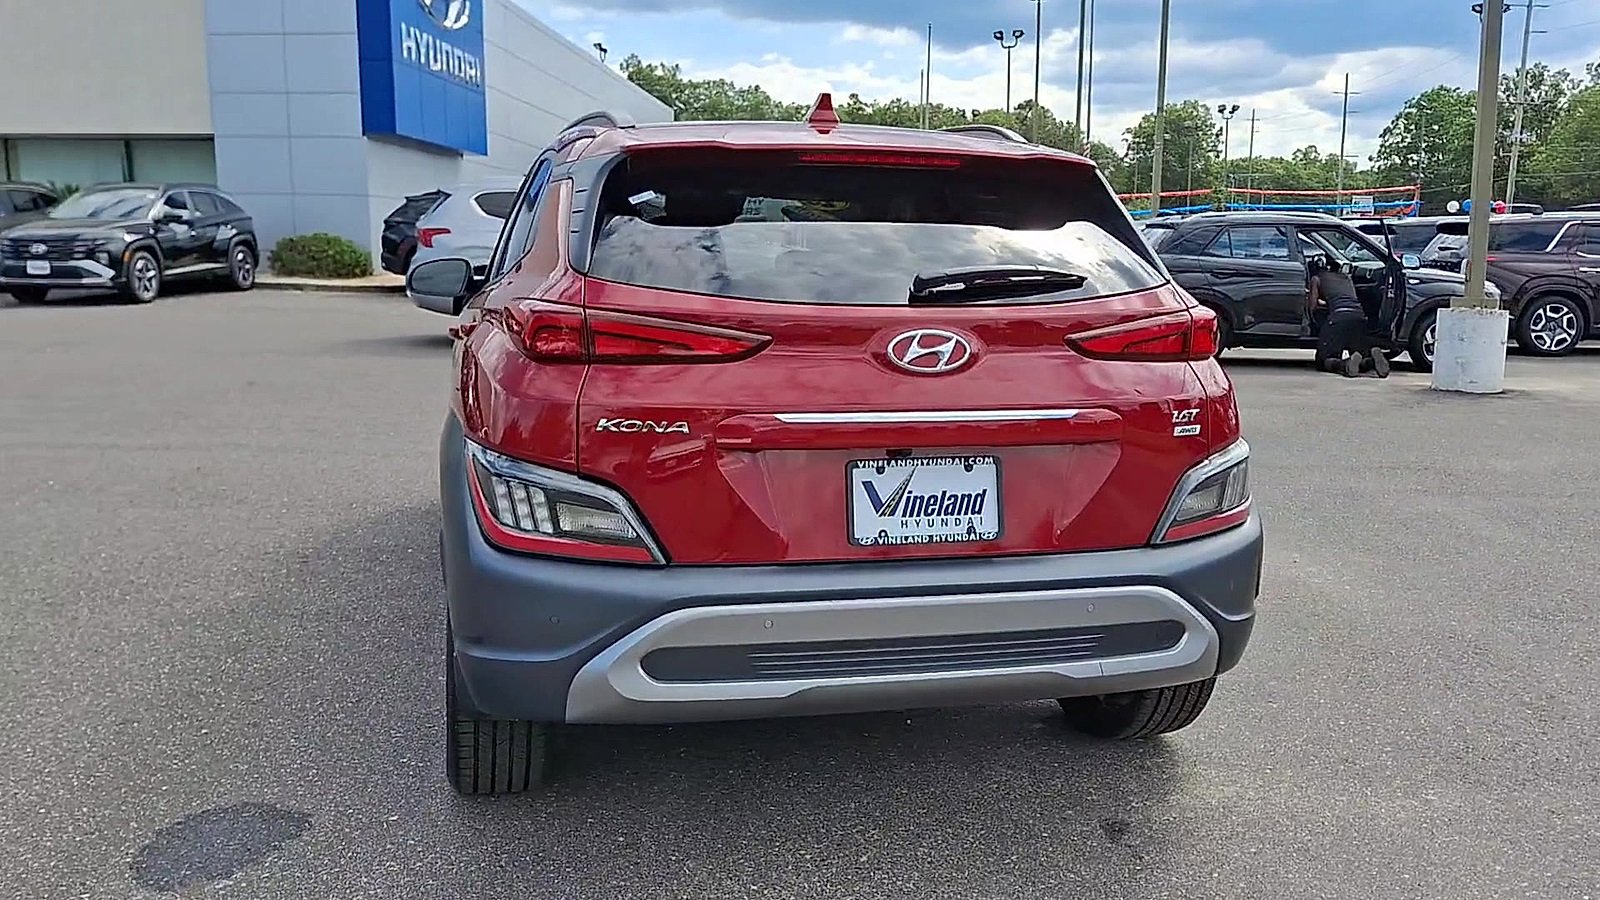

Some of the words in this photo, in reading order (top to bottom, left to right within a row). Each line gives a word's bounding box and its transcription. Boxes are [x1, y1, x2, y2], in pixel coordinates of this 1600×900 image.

[401, 21, 481, 84] HYUNDAI
[596, 418, 690, 434] KONA
[857, 456, 994, 469] VINELANDHYUNDAI.COM
[861, 467, 988, 518] Vineland
[900, 516, 984, 529] HYUNDAI
[877, 534, 930, 545] VINELAND
[932, 532, 980, 543] HYUNDAI
